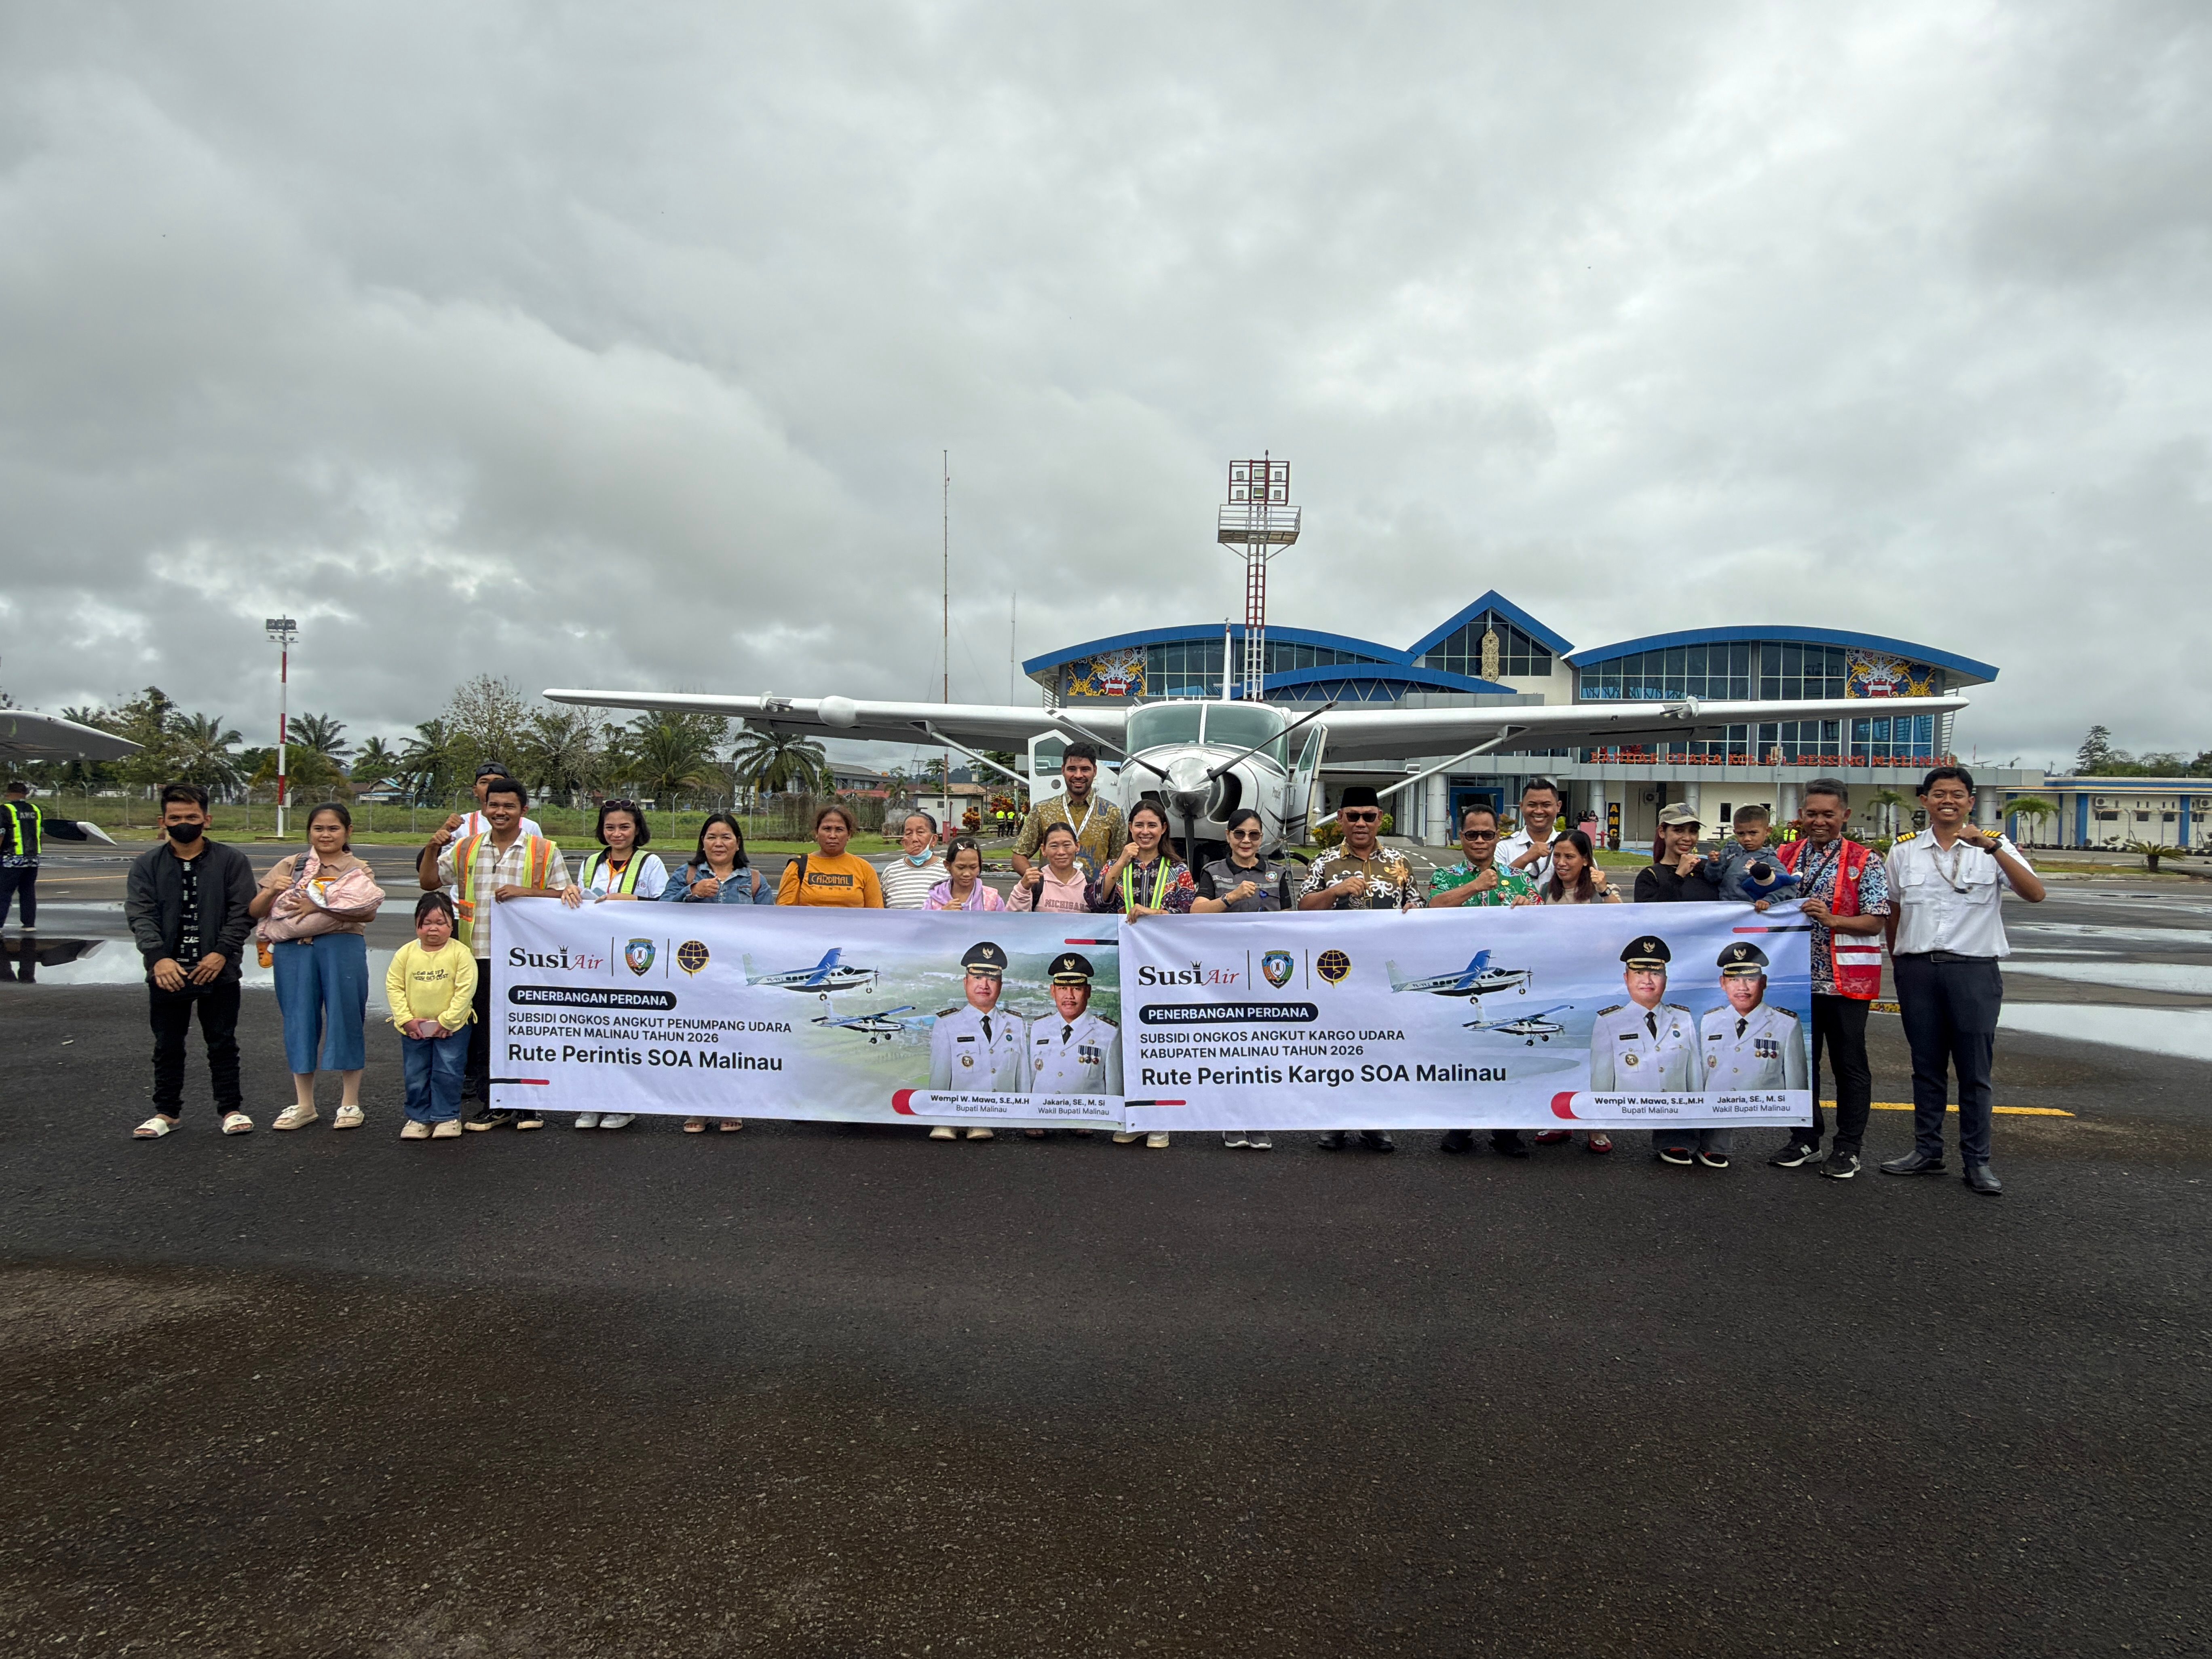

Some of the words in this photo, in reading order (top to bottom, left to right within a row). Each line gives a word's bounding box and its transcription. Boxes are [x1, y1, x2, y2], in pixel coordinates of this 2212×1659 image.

[1591, 752, 1657, 764] BANDAR
[1665, 753, 1723, 765] UDARA
[1797, 754, 1865, 766] BESSING
[1872, 755, 1954, 767] MALINAU
[1610, 804, 1618, 837] AMC
[811, 874, 850, 884] CARDINAL
[1044, 899, 1085, 912] MICHIGAN
[509, 946, 569, 969] Susi
[568, 954, 604, 970] Air
[1139, 965, 1203, 986] Susi
[1201, 969, 1239, 986] Air
[517, 990, 607, 1003] PENERBANGAN
[610, 994, 668, 1006] PERDANA
[1148, 1007, 1244, 1019] PENERBANGAN
[1247, 1007, 1309, 1017] PERDANA
[508, 1012, 556, 1023] SUBSIDI
[559, 1013, 610, 1026] ONGKOS
[613, 1016, 665, 1028] ANGKUT
[667, 1018, 745, 1031] PENUMPANG
[749, 1021, 792, 1033] UDARA
[508, 1025, 581, 1037] KABUPATEN
[584, 1028, 639, 1040] MALINAU
[642, 1030, 684, 1042] TAHUN
[687, 1032, 719, 1043] 2026
[1140, 1033, 1190, 1044] SUBSIDI
[1193, 1031, 1248, 1043] ONGKOS
[1251, 1030, 1306, 1041] ANGKUT
[1309, 1030, 1355, 1041] KARGO
[1359, 1030, 1405, 1041] UDARA
[509, 1044, 557, 1062] Rute
[563, 1045, 642, 1065] Perintis
[648, 1049, 693, 1067] SOA
[699, 1051, 782, 1071] Malinau
[1140, 1047, 1216, 1059] KABUPATEN
[1220, 1046, 1279, 1057] MALINAU
[1282, 1045, 1327, 1056] TAHUN
[1330, 1045, 1364, 1055] 2026
[1142, 1068, 1192, 1085] Rute
[1198, 1065, 1282, 1085] Perintis
[1289, 1065, 1354, 1087] Kargo
[1361, 1064, 1410, 1082] SOA
[1416, 1063, 1506, 1082] Malinau
[931, 1095, 959, 1104] Wempi
[972, 1096, 998, 1104] Mawa,
[1594, 1097, 1626, 1106] Wempi
[956, 1104, 978, 1113] Bupati
[1058, 1107, 1081, 1115] Bupati
[1622, 1106, 1646, 1115] Bupati
[1734, 1105, 1758, 1113] Bupati
